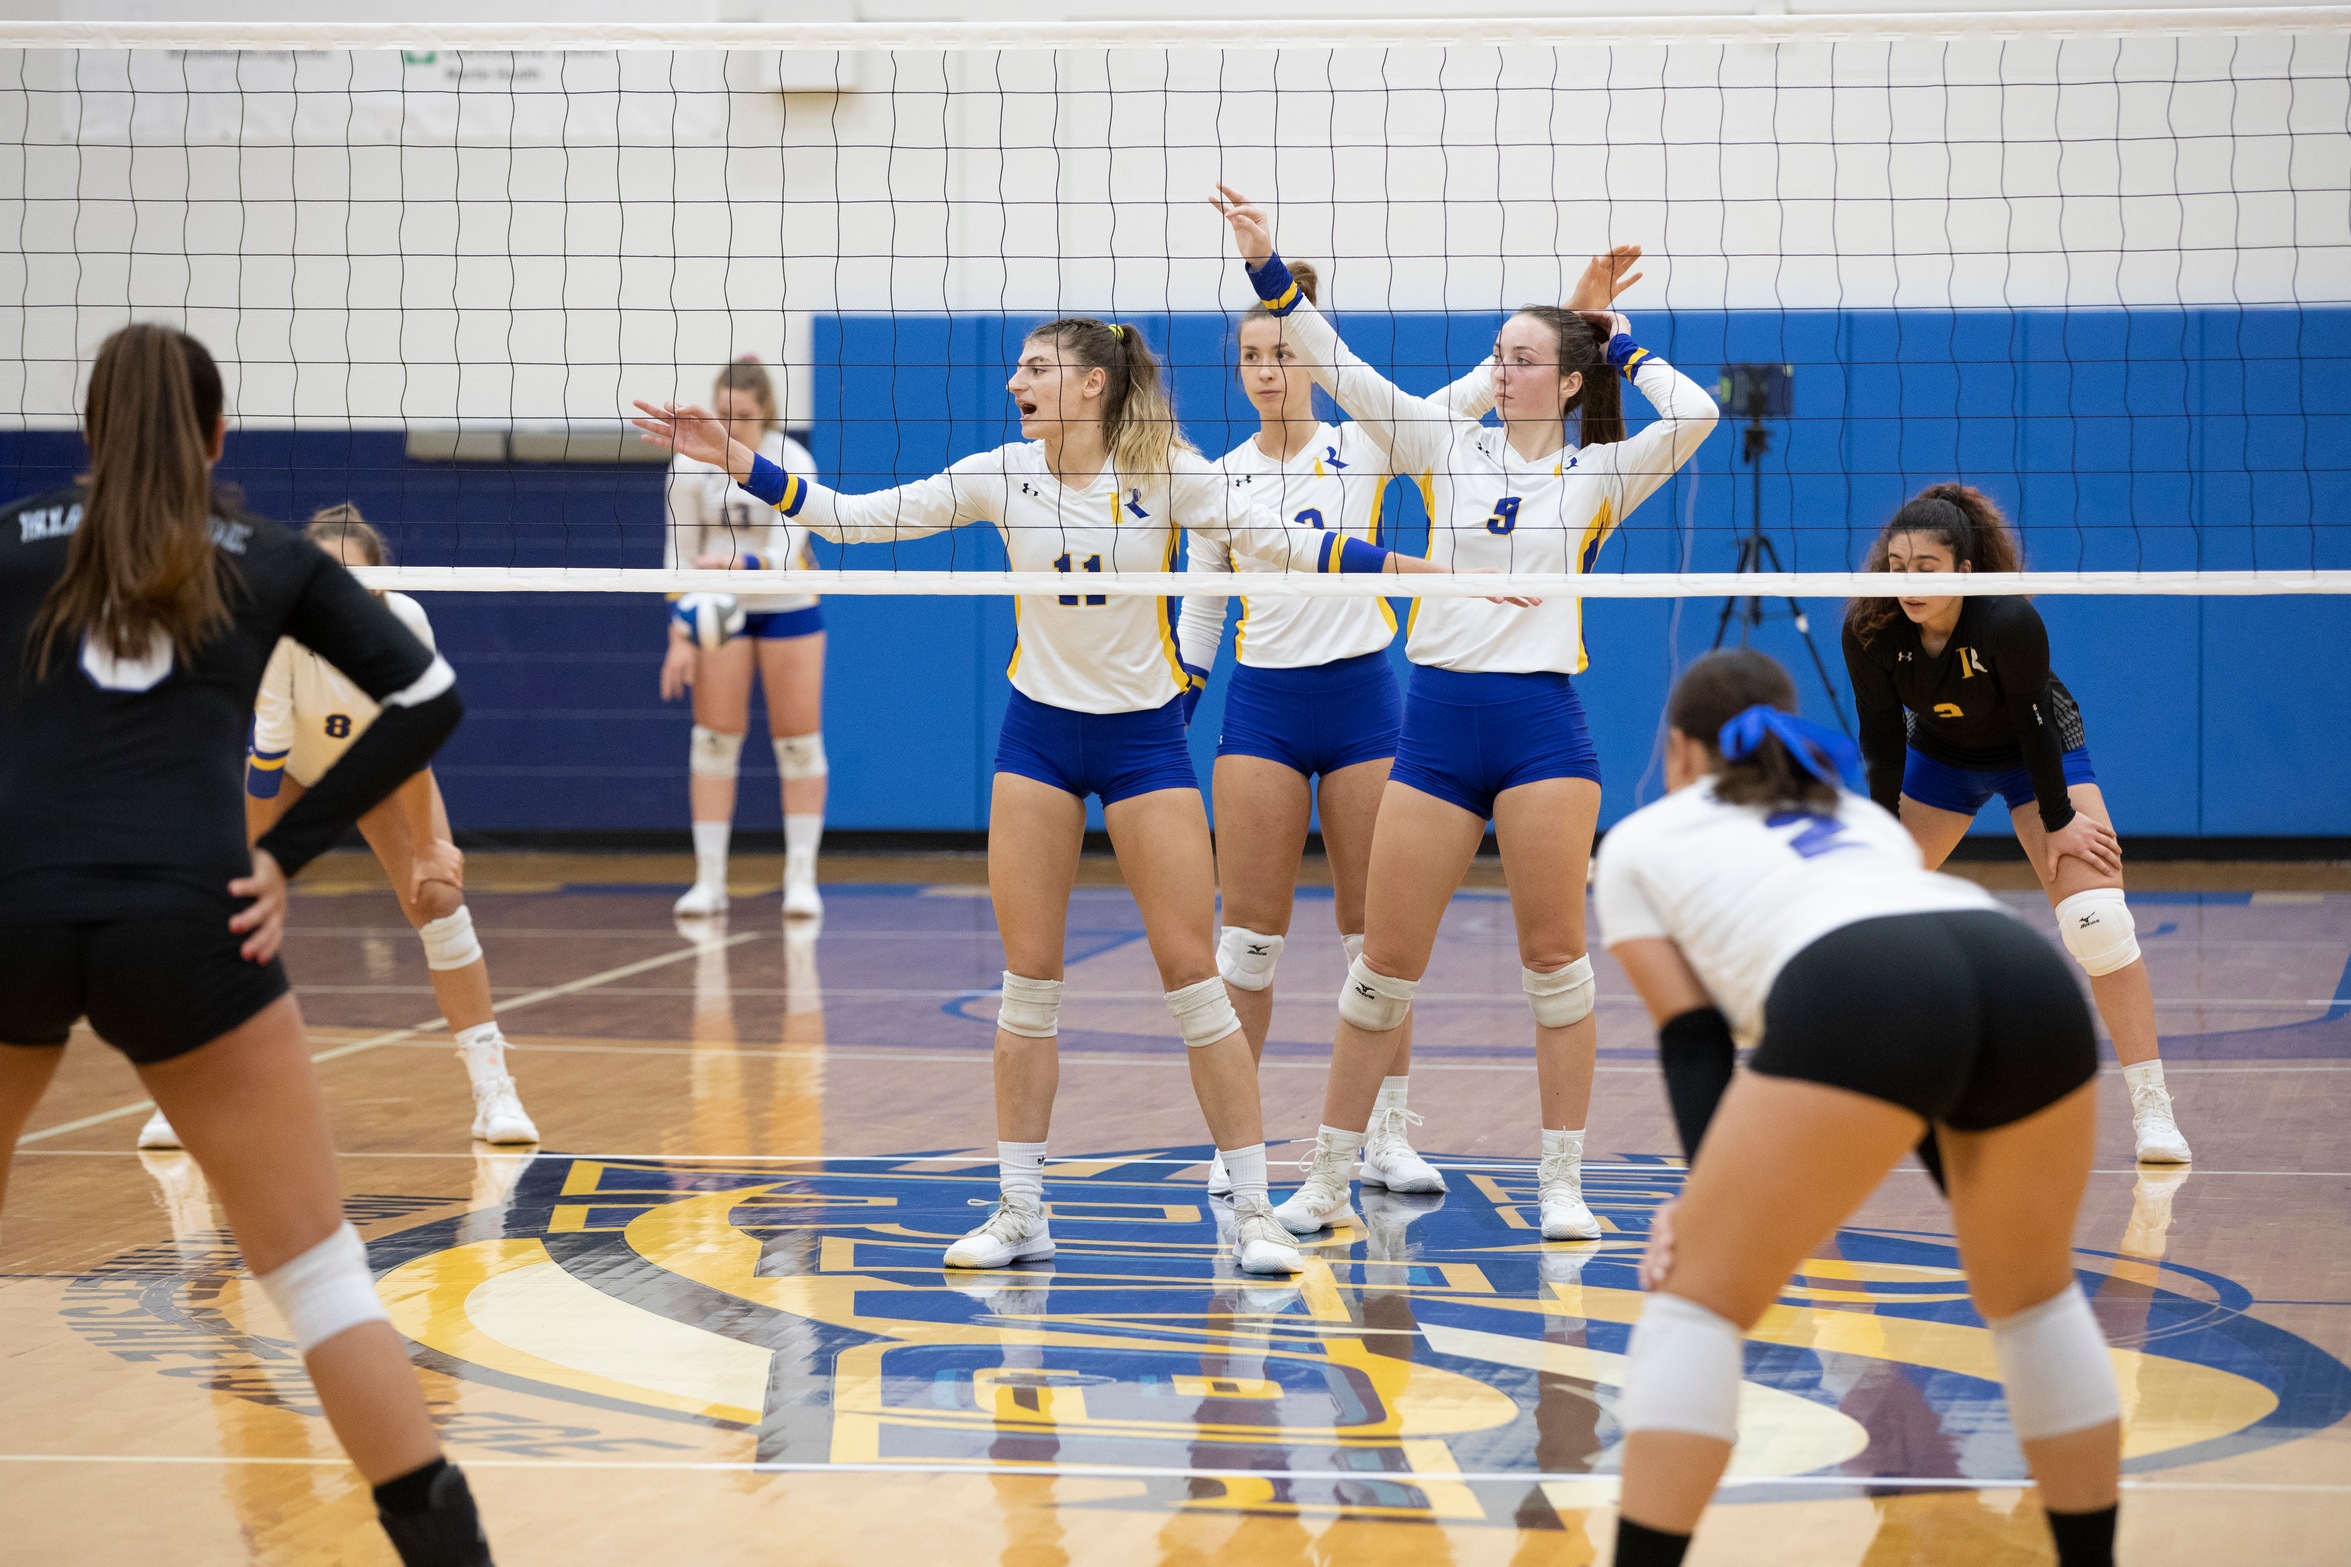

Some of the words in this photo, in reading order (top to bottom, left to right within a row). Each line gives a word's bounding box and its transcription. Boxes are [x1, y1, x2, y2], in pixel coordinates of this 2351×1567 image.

[1486, 496, 1523, 536] 9
[1052, 552, 1108, 607] 11
[324, 713, 352, 739] 8
